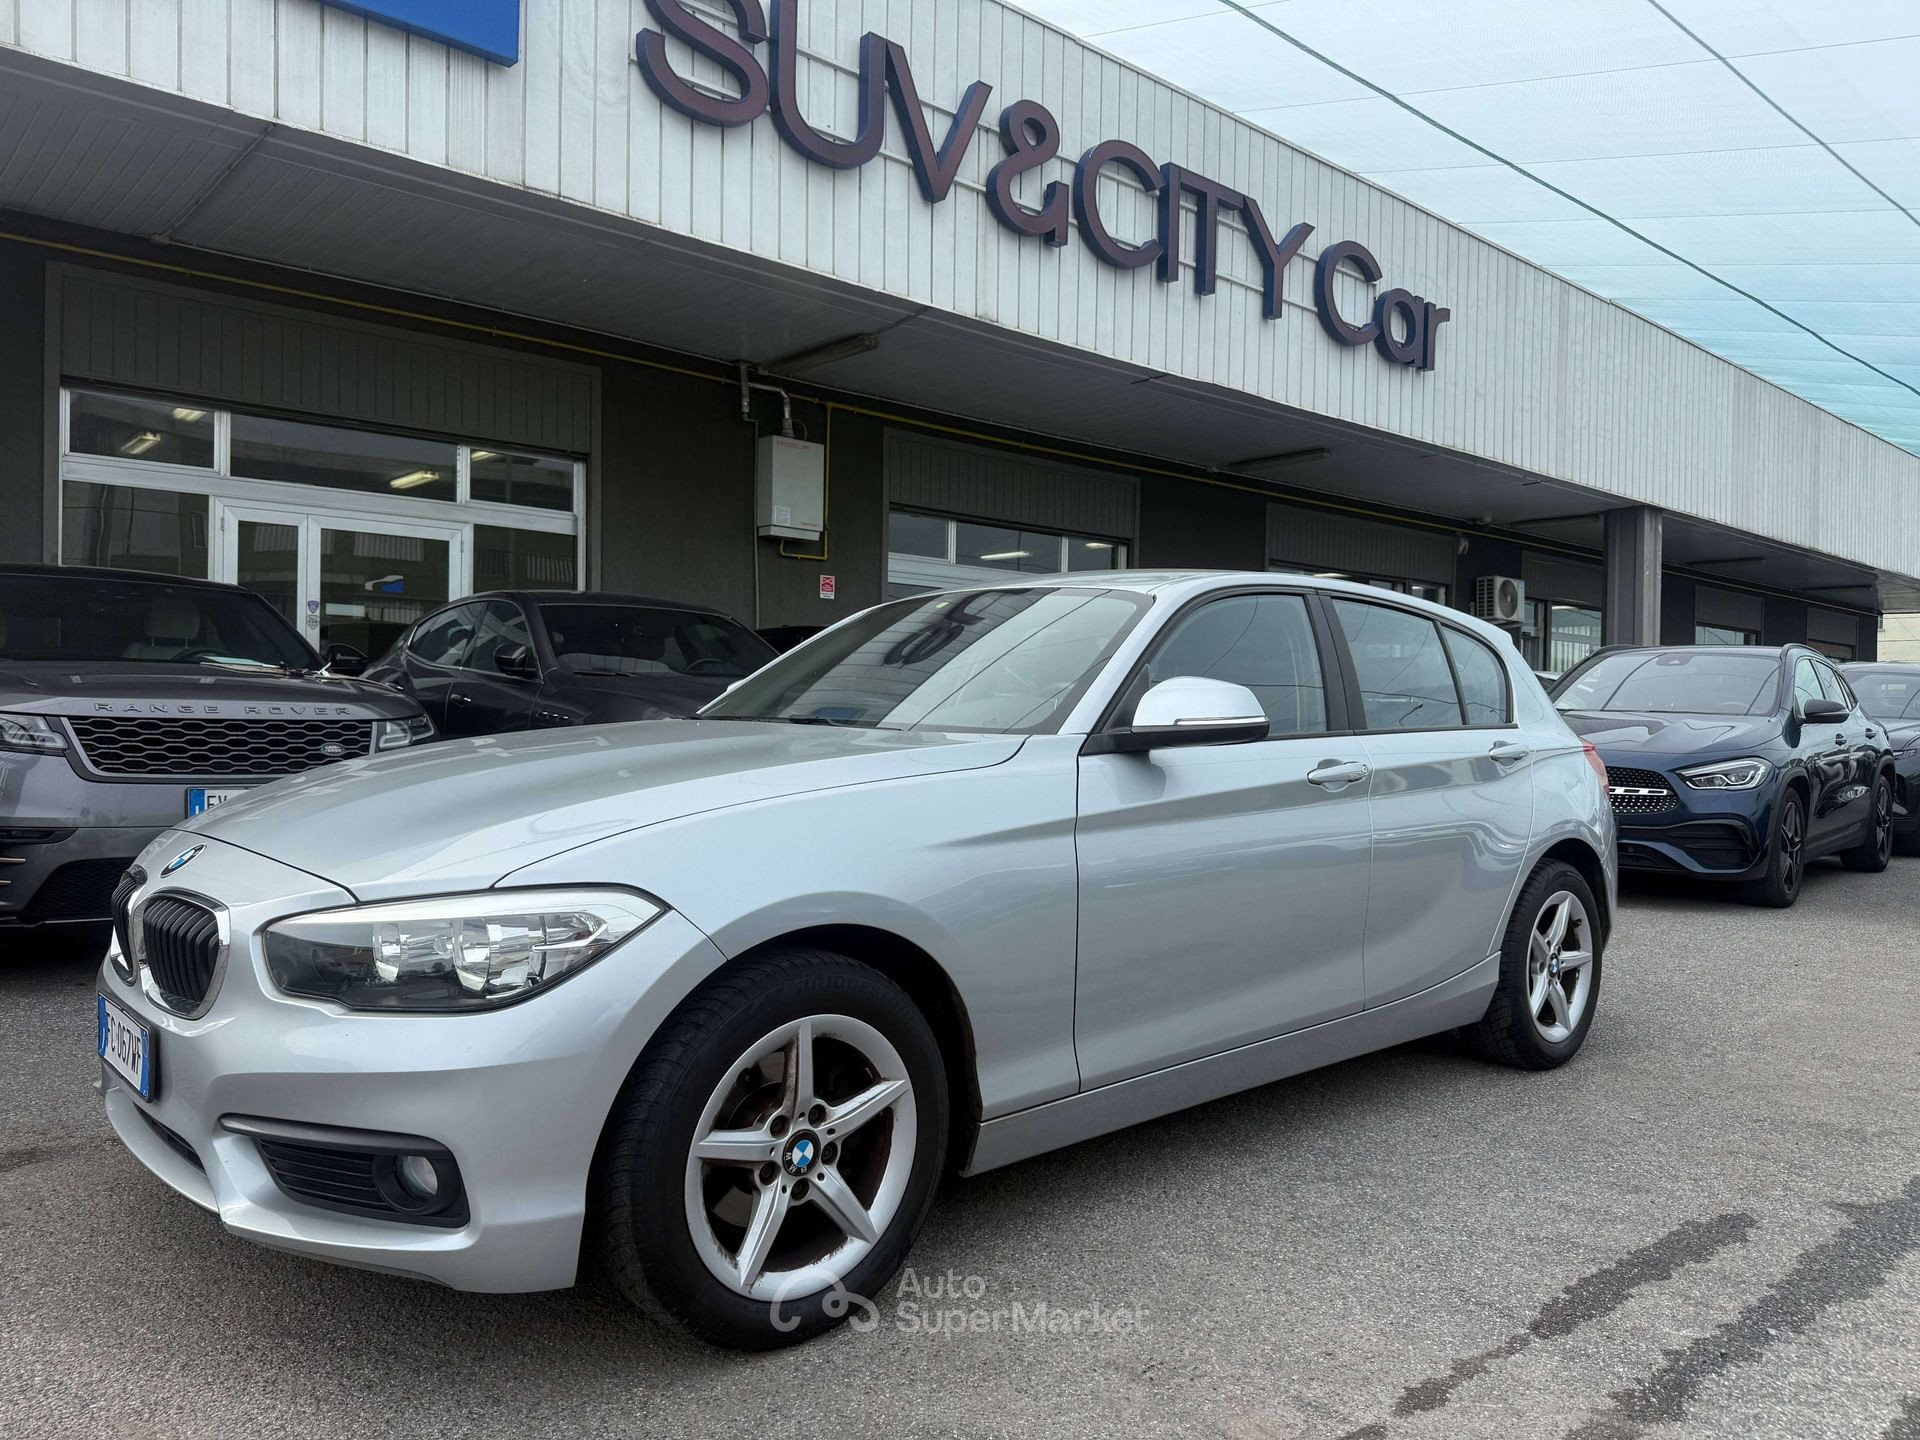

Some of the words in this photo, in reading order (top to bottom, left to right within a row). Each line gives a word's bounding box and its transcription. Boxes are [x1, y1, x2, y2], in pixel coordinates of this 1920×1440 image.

[1315, 240, 1450, 371] Car
[94, 702, 219, 714] RANGE
[244, 705, 350, 716] ROVER
